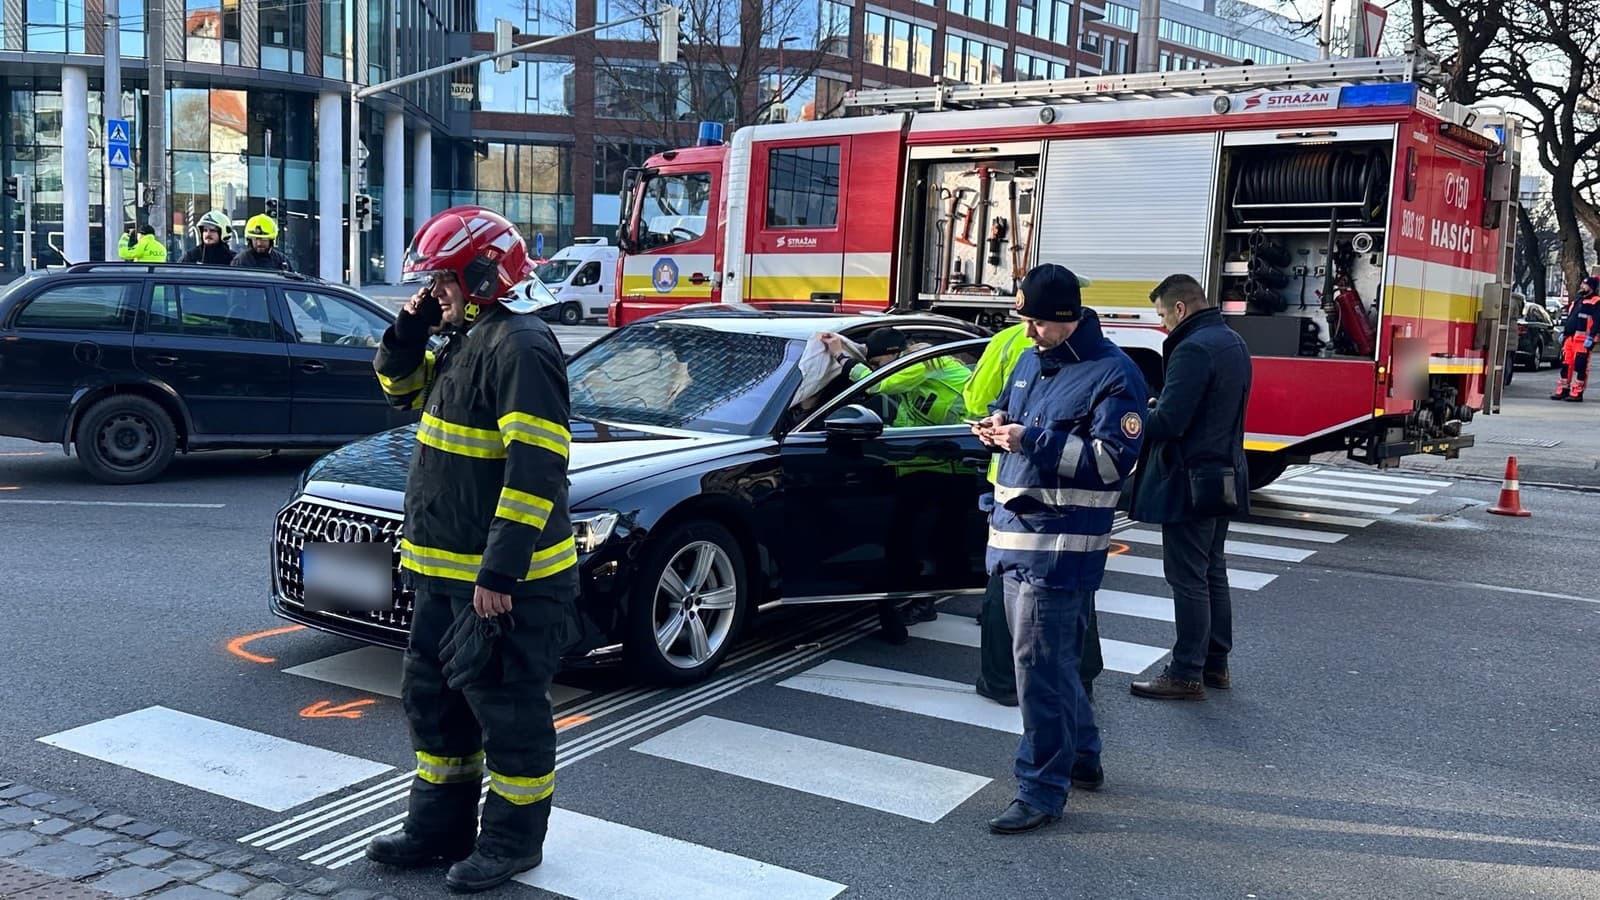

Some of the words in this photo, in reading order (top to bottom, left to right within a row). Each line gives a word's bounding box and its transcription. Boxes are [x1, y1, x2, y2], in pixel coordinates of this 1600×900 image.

[1267, 92, 1329, 105] STRAŽAN
[1454, 176, 1469, 210] 150
[787, 236, 817, 244] STRAŽAN
[1401, 209, 1414, 239] SOS
[1415, 215, 1425, 241] 112
[1430, 218, 1475, 255] HASIČI
